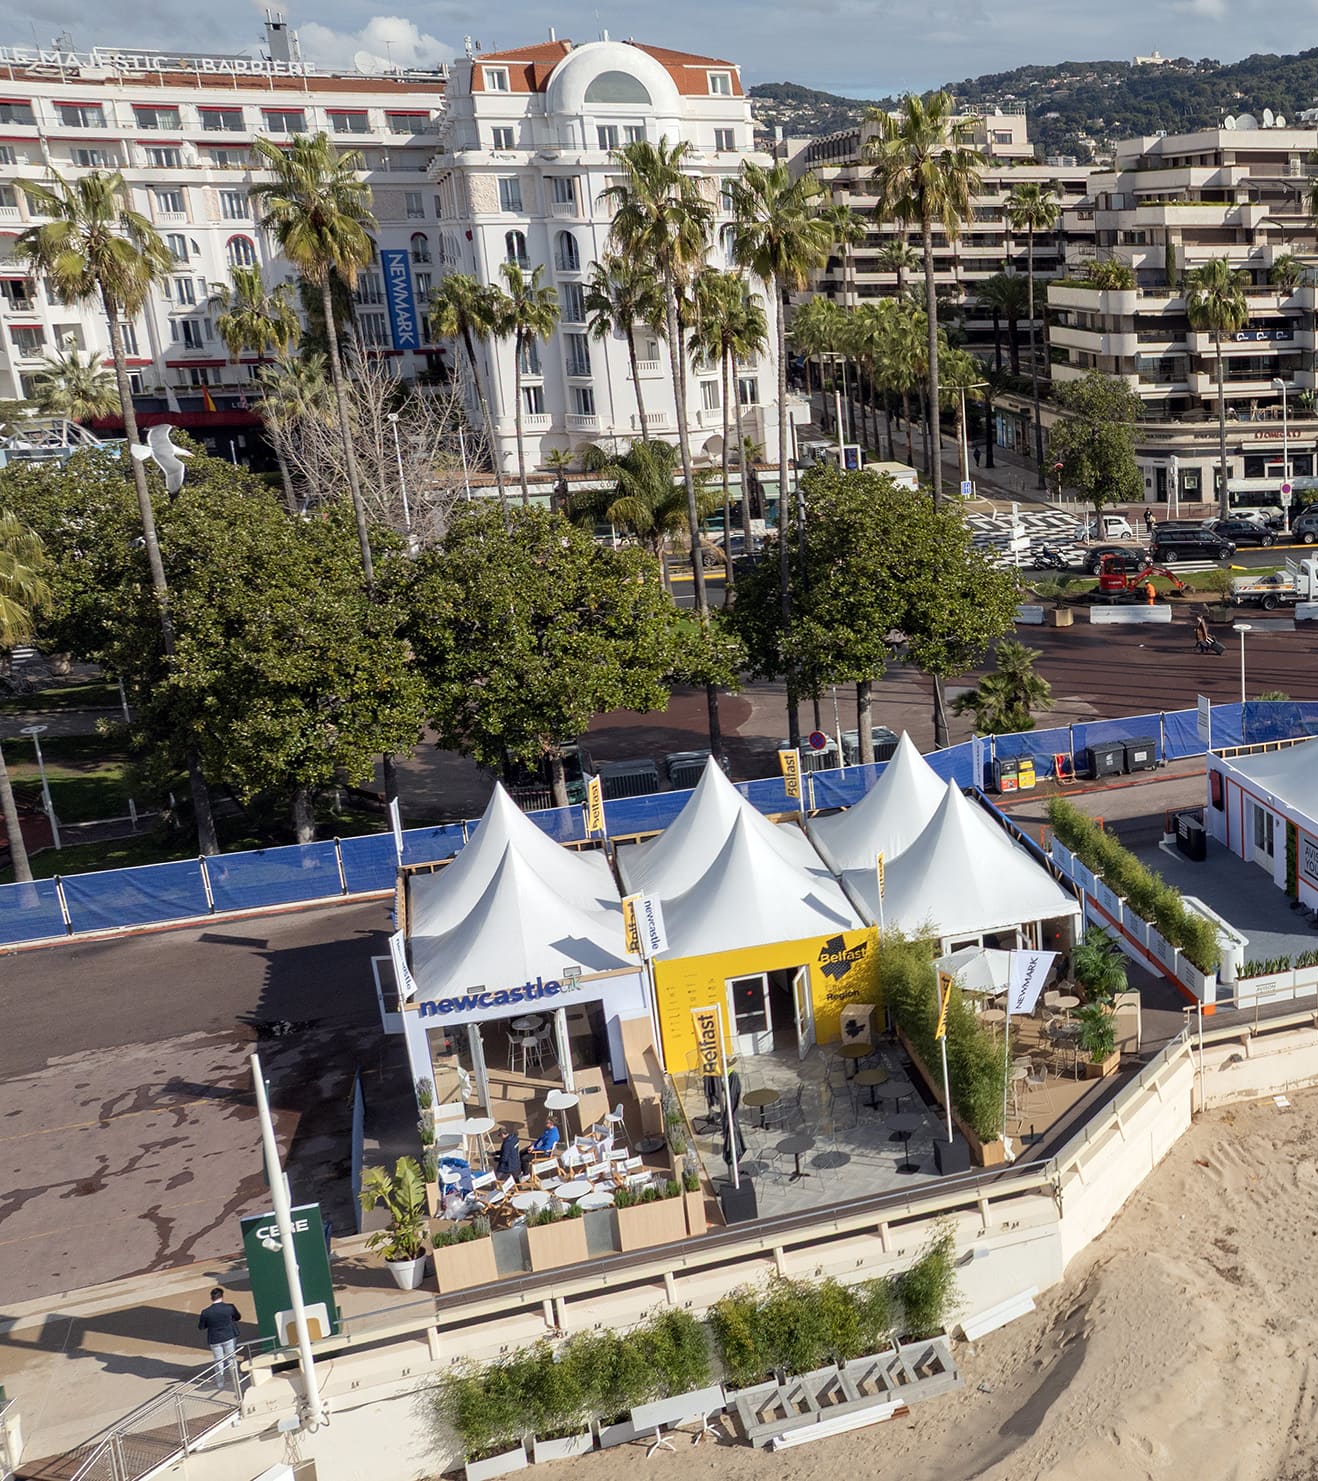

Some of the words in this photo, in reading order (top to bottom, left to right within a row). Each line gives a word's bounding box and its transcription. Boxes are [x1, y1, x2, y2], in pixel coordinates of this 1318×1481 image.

[40, 50, 168, 72] MAJESTIC
[388, 253, 415, 345] NEWMARK
[784, 755, 797, 796] Belfast
[644, 900, 661, 950] newcastle
[821, 947, 867, 963] Belfast
[419, 976, 561, 1018] newcastle
[826, 990, 860, 1000] Region
[1015, 956, 1039, 1009] NEWMARK
[698, 1015, 718, 1074] Belfast
